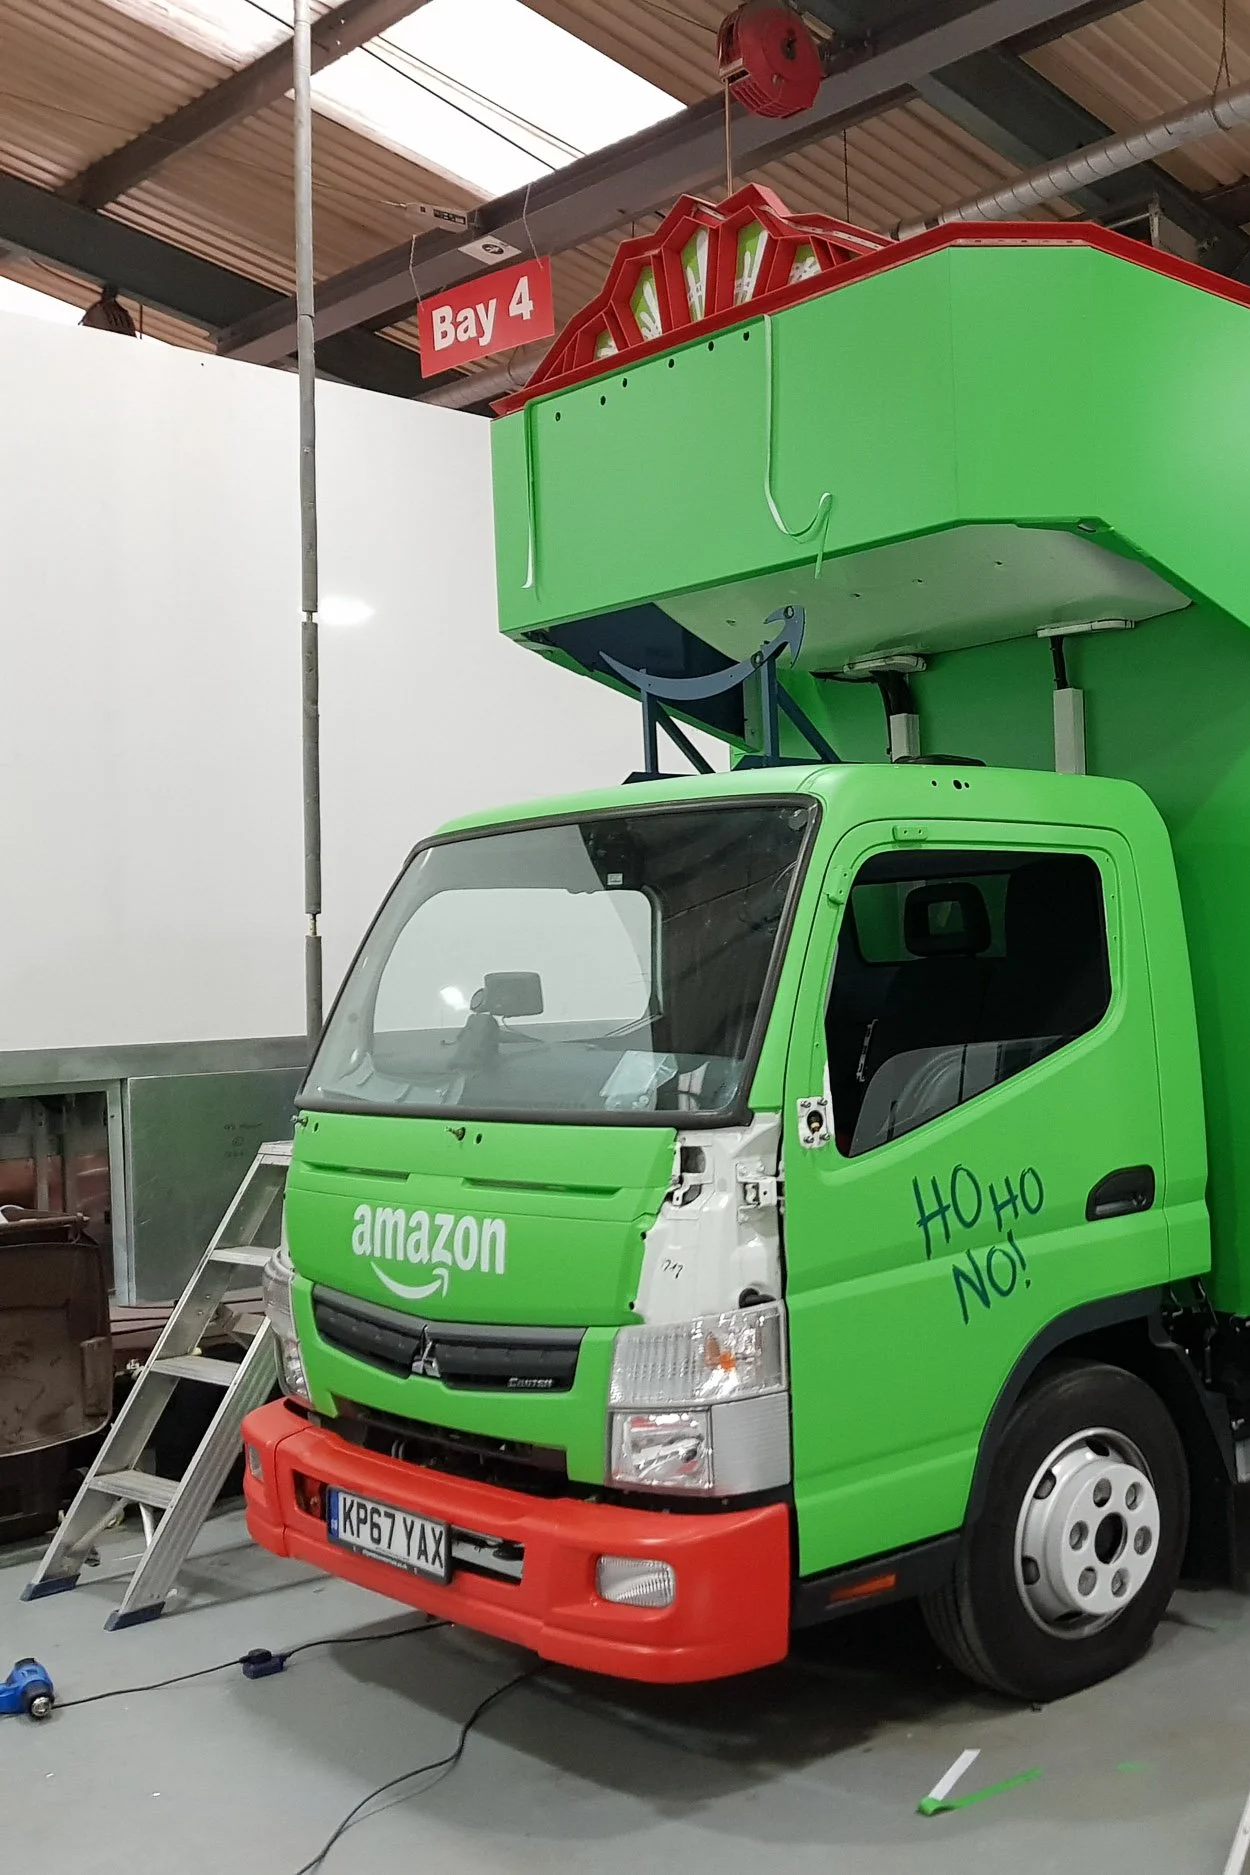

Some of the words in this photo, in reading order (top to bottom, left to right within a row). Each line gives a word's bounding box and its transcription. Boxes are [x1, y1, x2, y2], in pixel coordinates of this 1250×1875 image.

[432, 298, 497, 352] Bay
[508, 275, 534, 321] 4
[352, 1204, 506, 1275] amazon
[952, 1229, 1031, 1325] NO!
[343, 1496, 396, 1550] KP67
[402, 1516, 444, 1569] YAX
